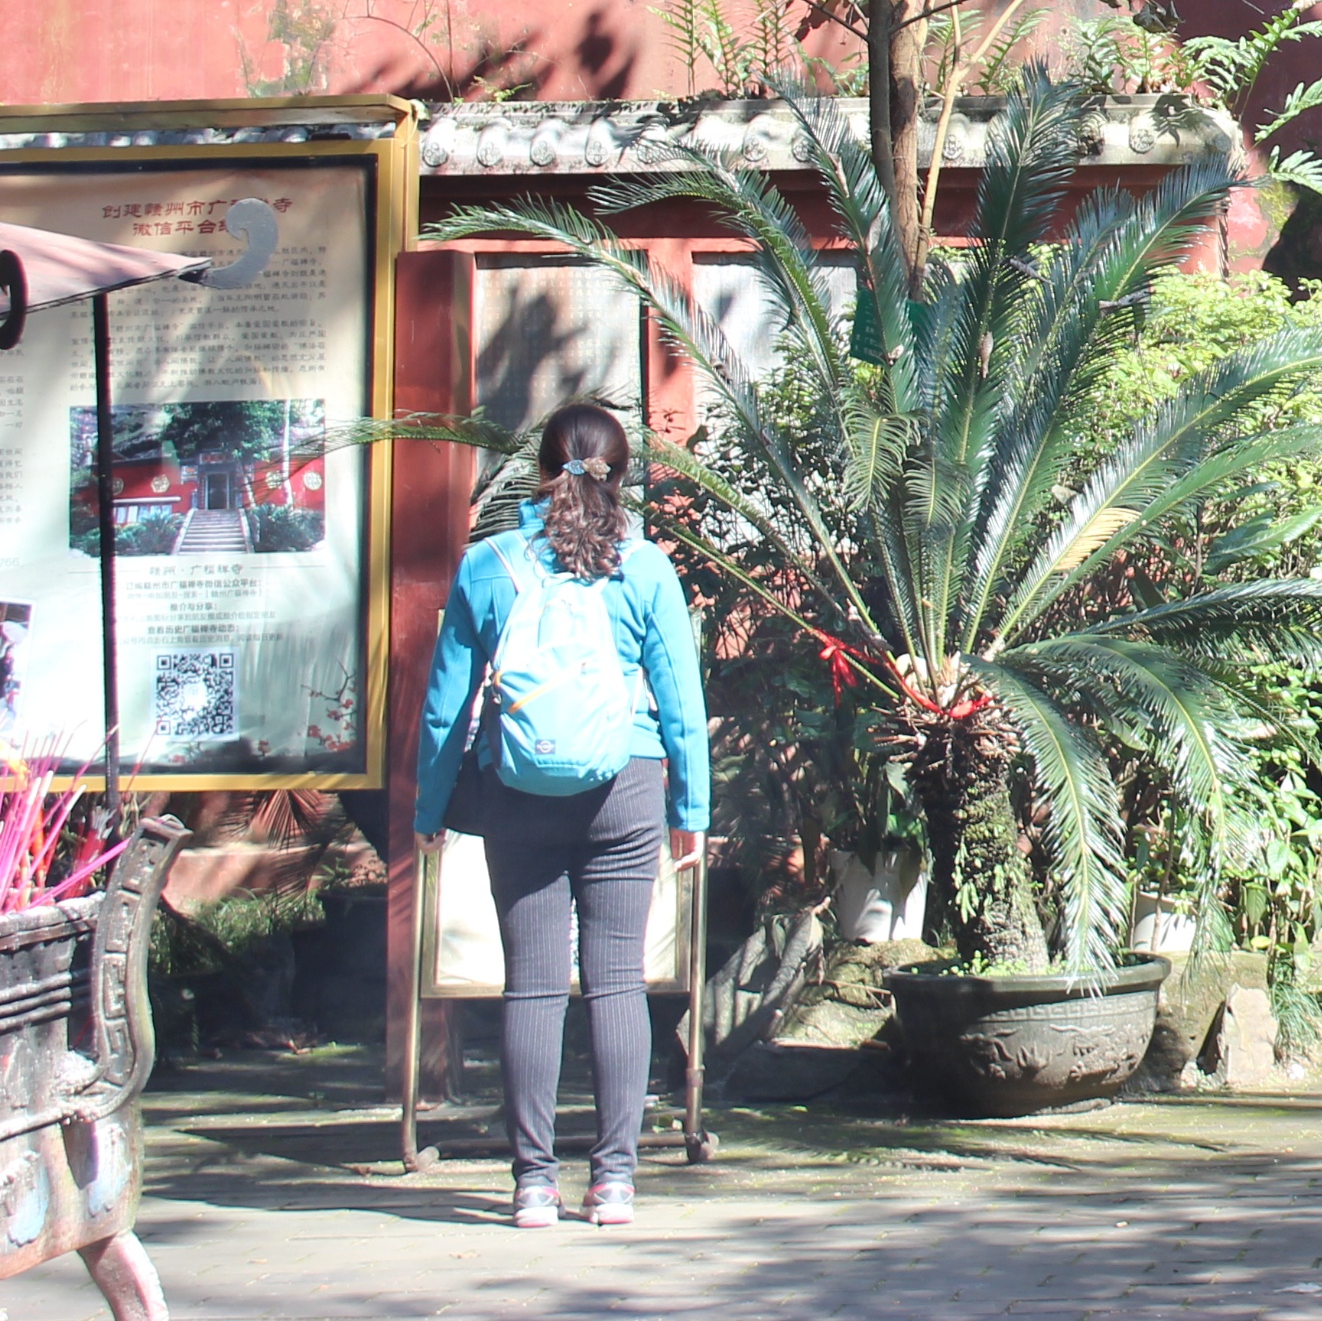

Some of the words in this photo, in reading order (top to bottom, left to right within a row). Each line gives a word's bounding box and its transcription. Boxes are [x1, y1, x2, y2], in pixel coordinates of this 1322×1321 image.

[101, 196, 293, 219] 创建赣州市广寺
